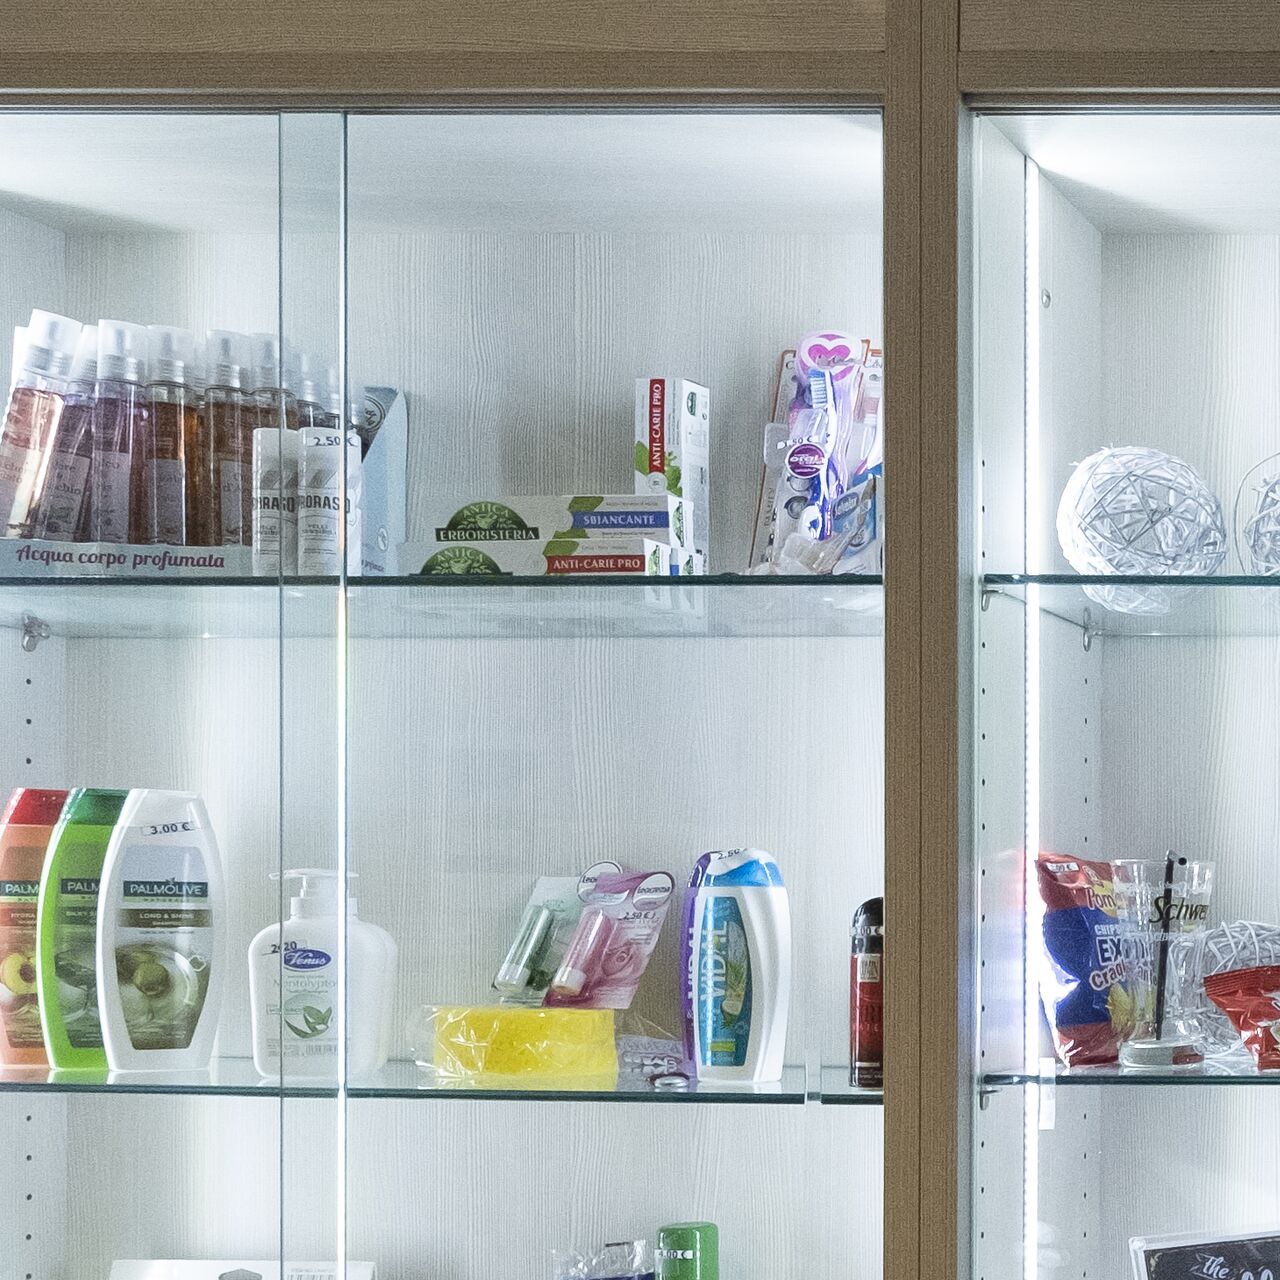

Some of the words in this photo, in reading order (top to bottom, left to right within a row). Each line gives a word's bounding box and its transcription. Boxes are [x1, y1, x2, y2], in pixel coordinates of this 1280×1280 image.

[16, 546, 75, 566] Acqua
[78, 551, 127, 569] corpo
[132, 545, 225, 571] profumata
[553, 558, 615, 570] ANTI-CARIE
[617, 557, 640, 569] PRO
[130, 883, 203, 895] PALMOLIVE
[285, 951, 327, 967] Venus
